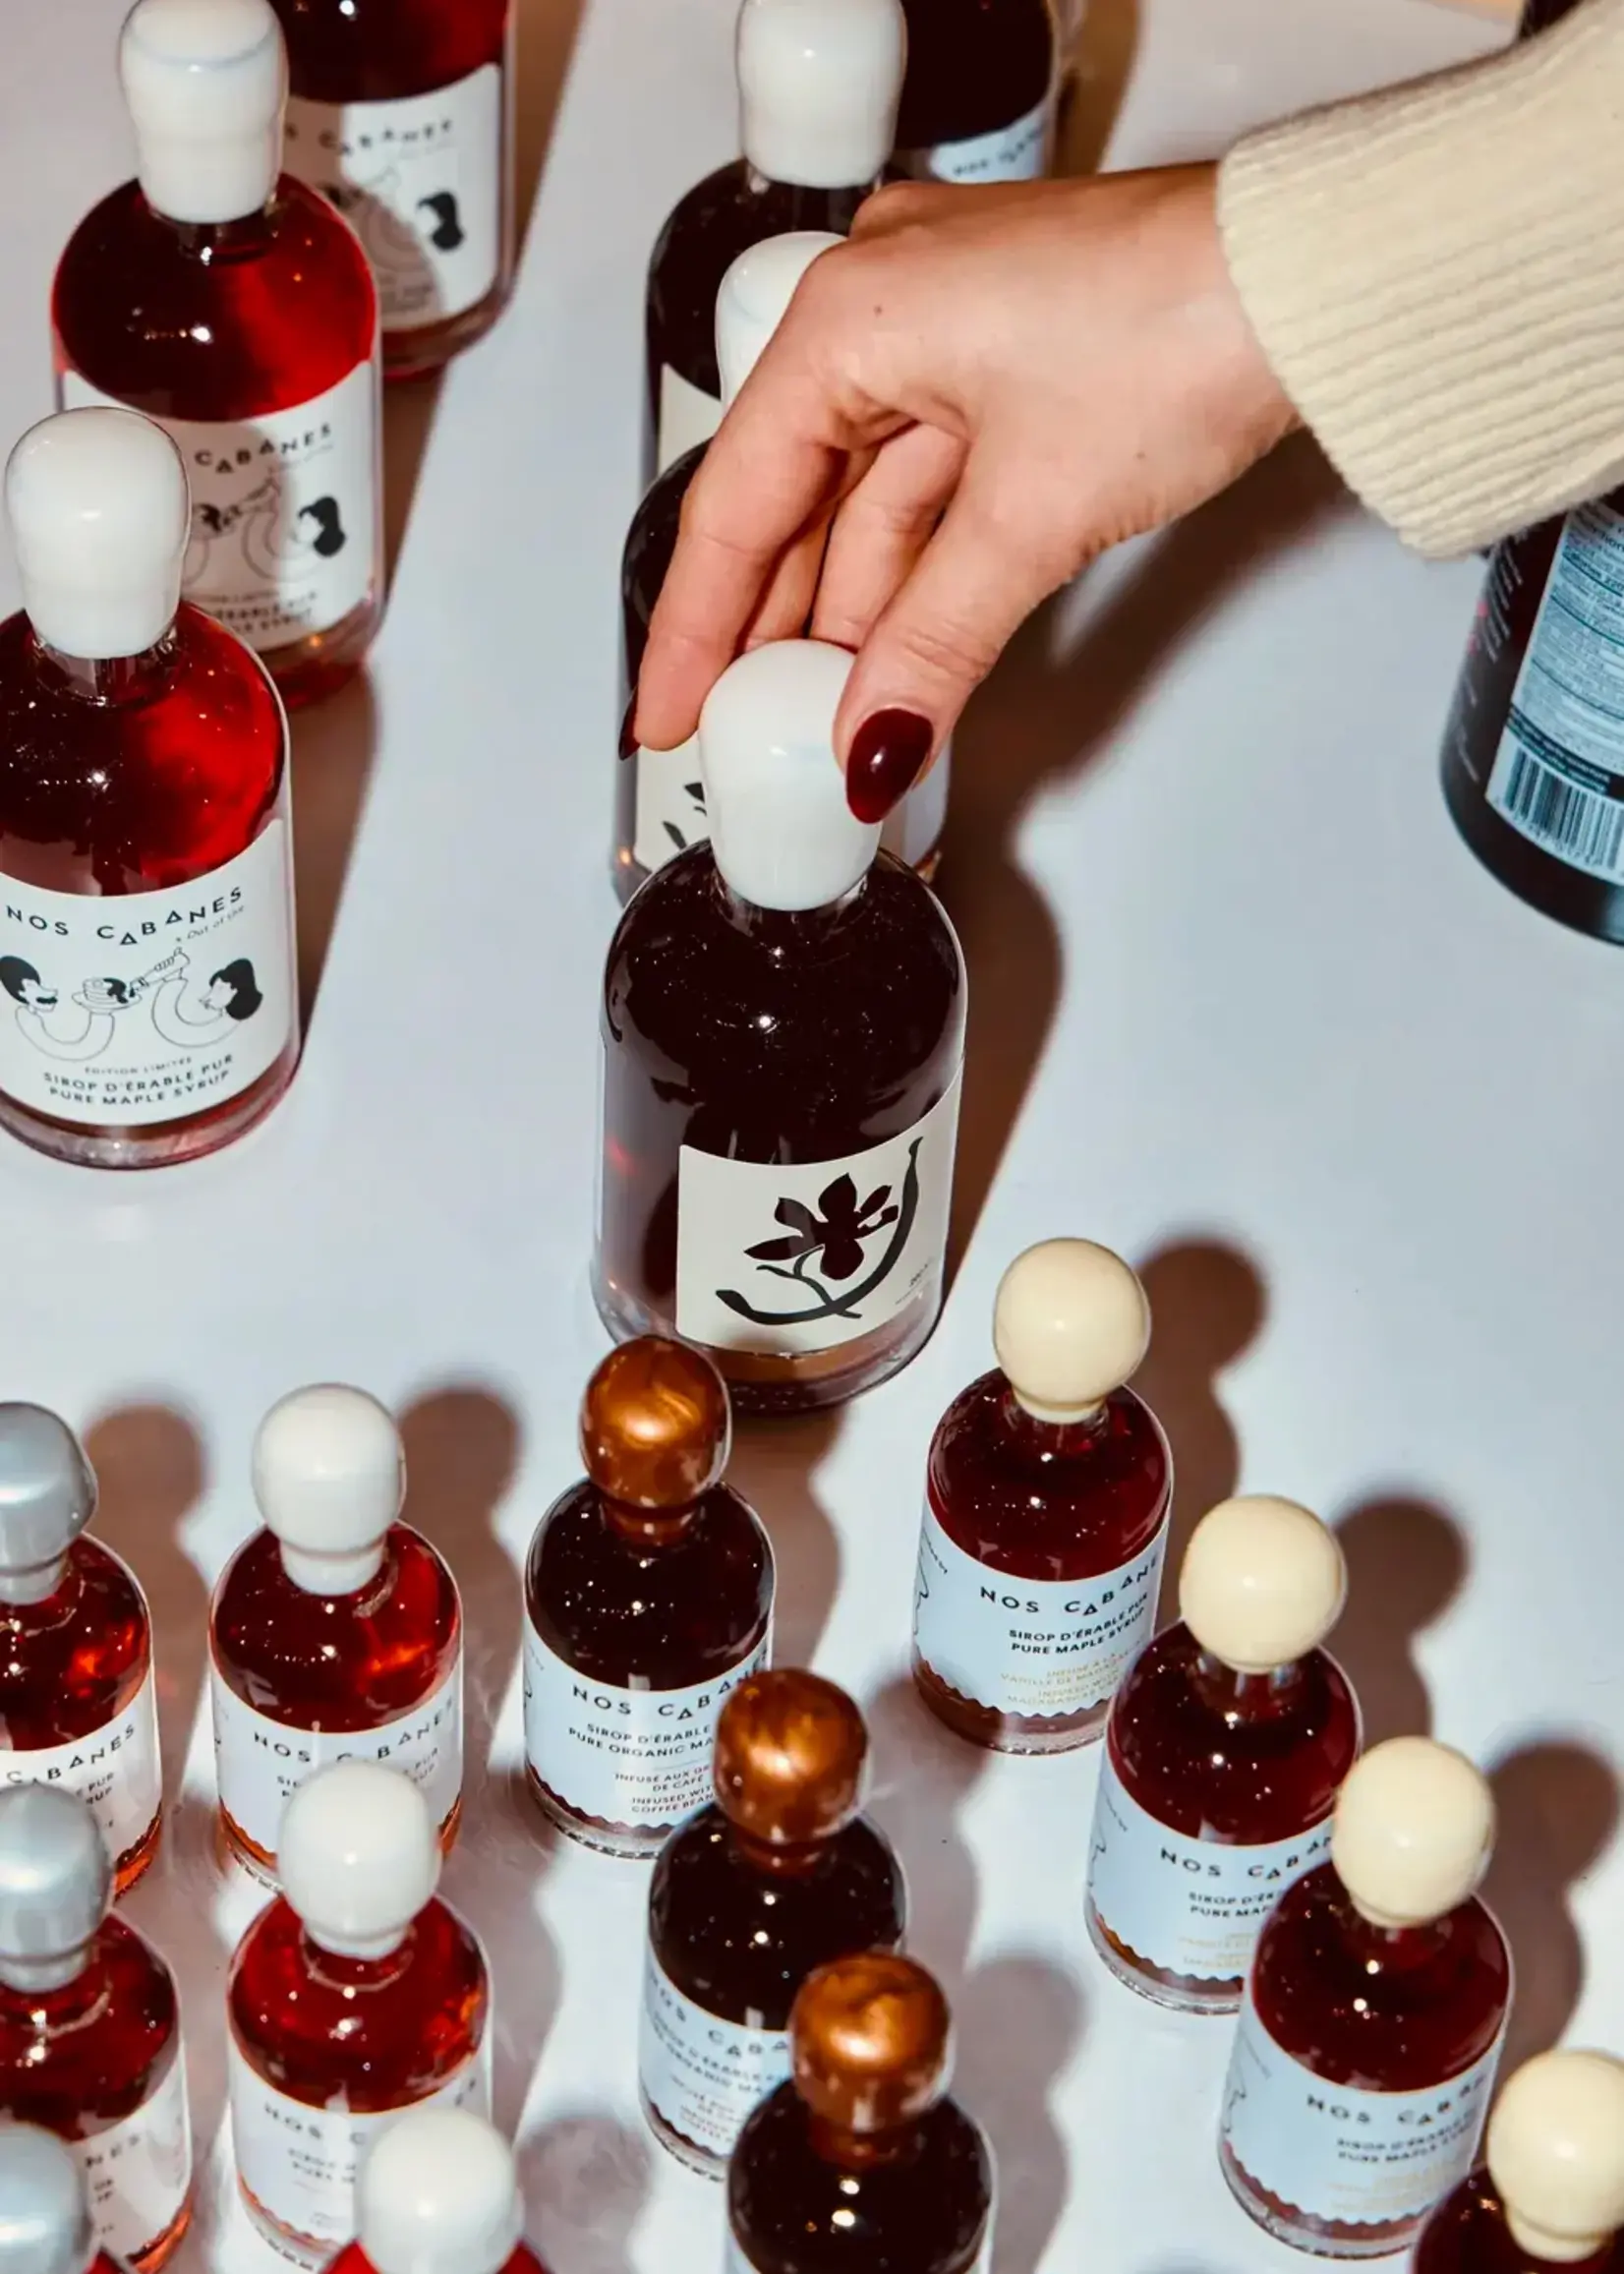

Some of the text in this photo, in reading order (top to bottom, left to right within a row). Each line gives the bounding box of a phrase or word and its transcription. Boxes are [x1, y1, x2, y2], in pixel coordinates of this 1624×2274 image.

[7, 886, 242, 945] NOS CABANES
[43, 1053, 232, 1093] SIROP D'ÉRABLE PUR
[50, 1070, 229, 1105] PURE MAPLE SYRUP
[980, 1556, 1157, 1616] NOS CABANE
[1009, 1629, 1055, 1642] SIROP
[1061, 1610, 1126, 1642] D'ÉRABLE
[1011, 1605, 1145, 1655] PURE MAPLE SYRUP
[572, 1685, 632, 1716] NOS
[254, 1731, 311, 1763] NOS
[568, 1727, 685, 1758] PURE ORGANIC
[587, 1723, 711, 1743] SIROP D'ÉRABLE
[631, 1792, 715, 1813] COFFEE BEAN
[632, 1784, 712, 1805] INFUSED WIT
[1160, 1848, 1222, 1878] NOS
[1188, 1892, 1237, 1905] SIROP
[1189, 1904, 1231, 1918] PURE
[707, 2029, 788, 2059] CABA
[264, 2104, 322, 2140] NOS
[1306, 2094, 1370, 2123] NOS
